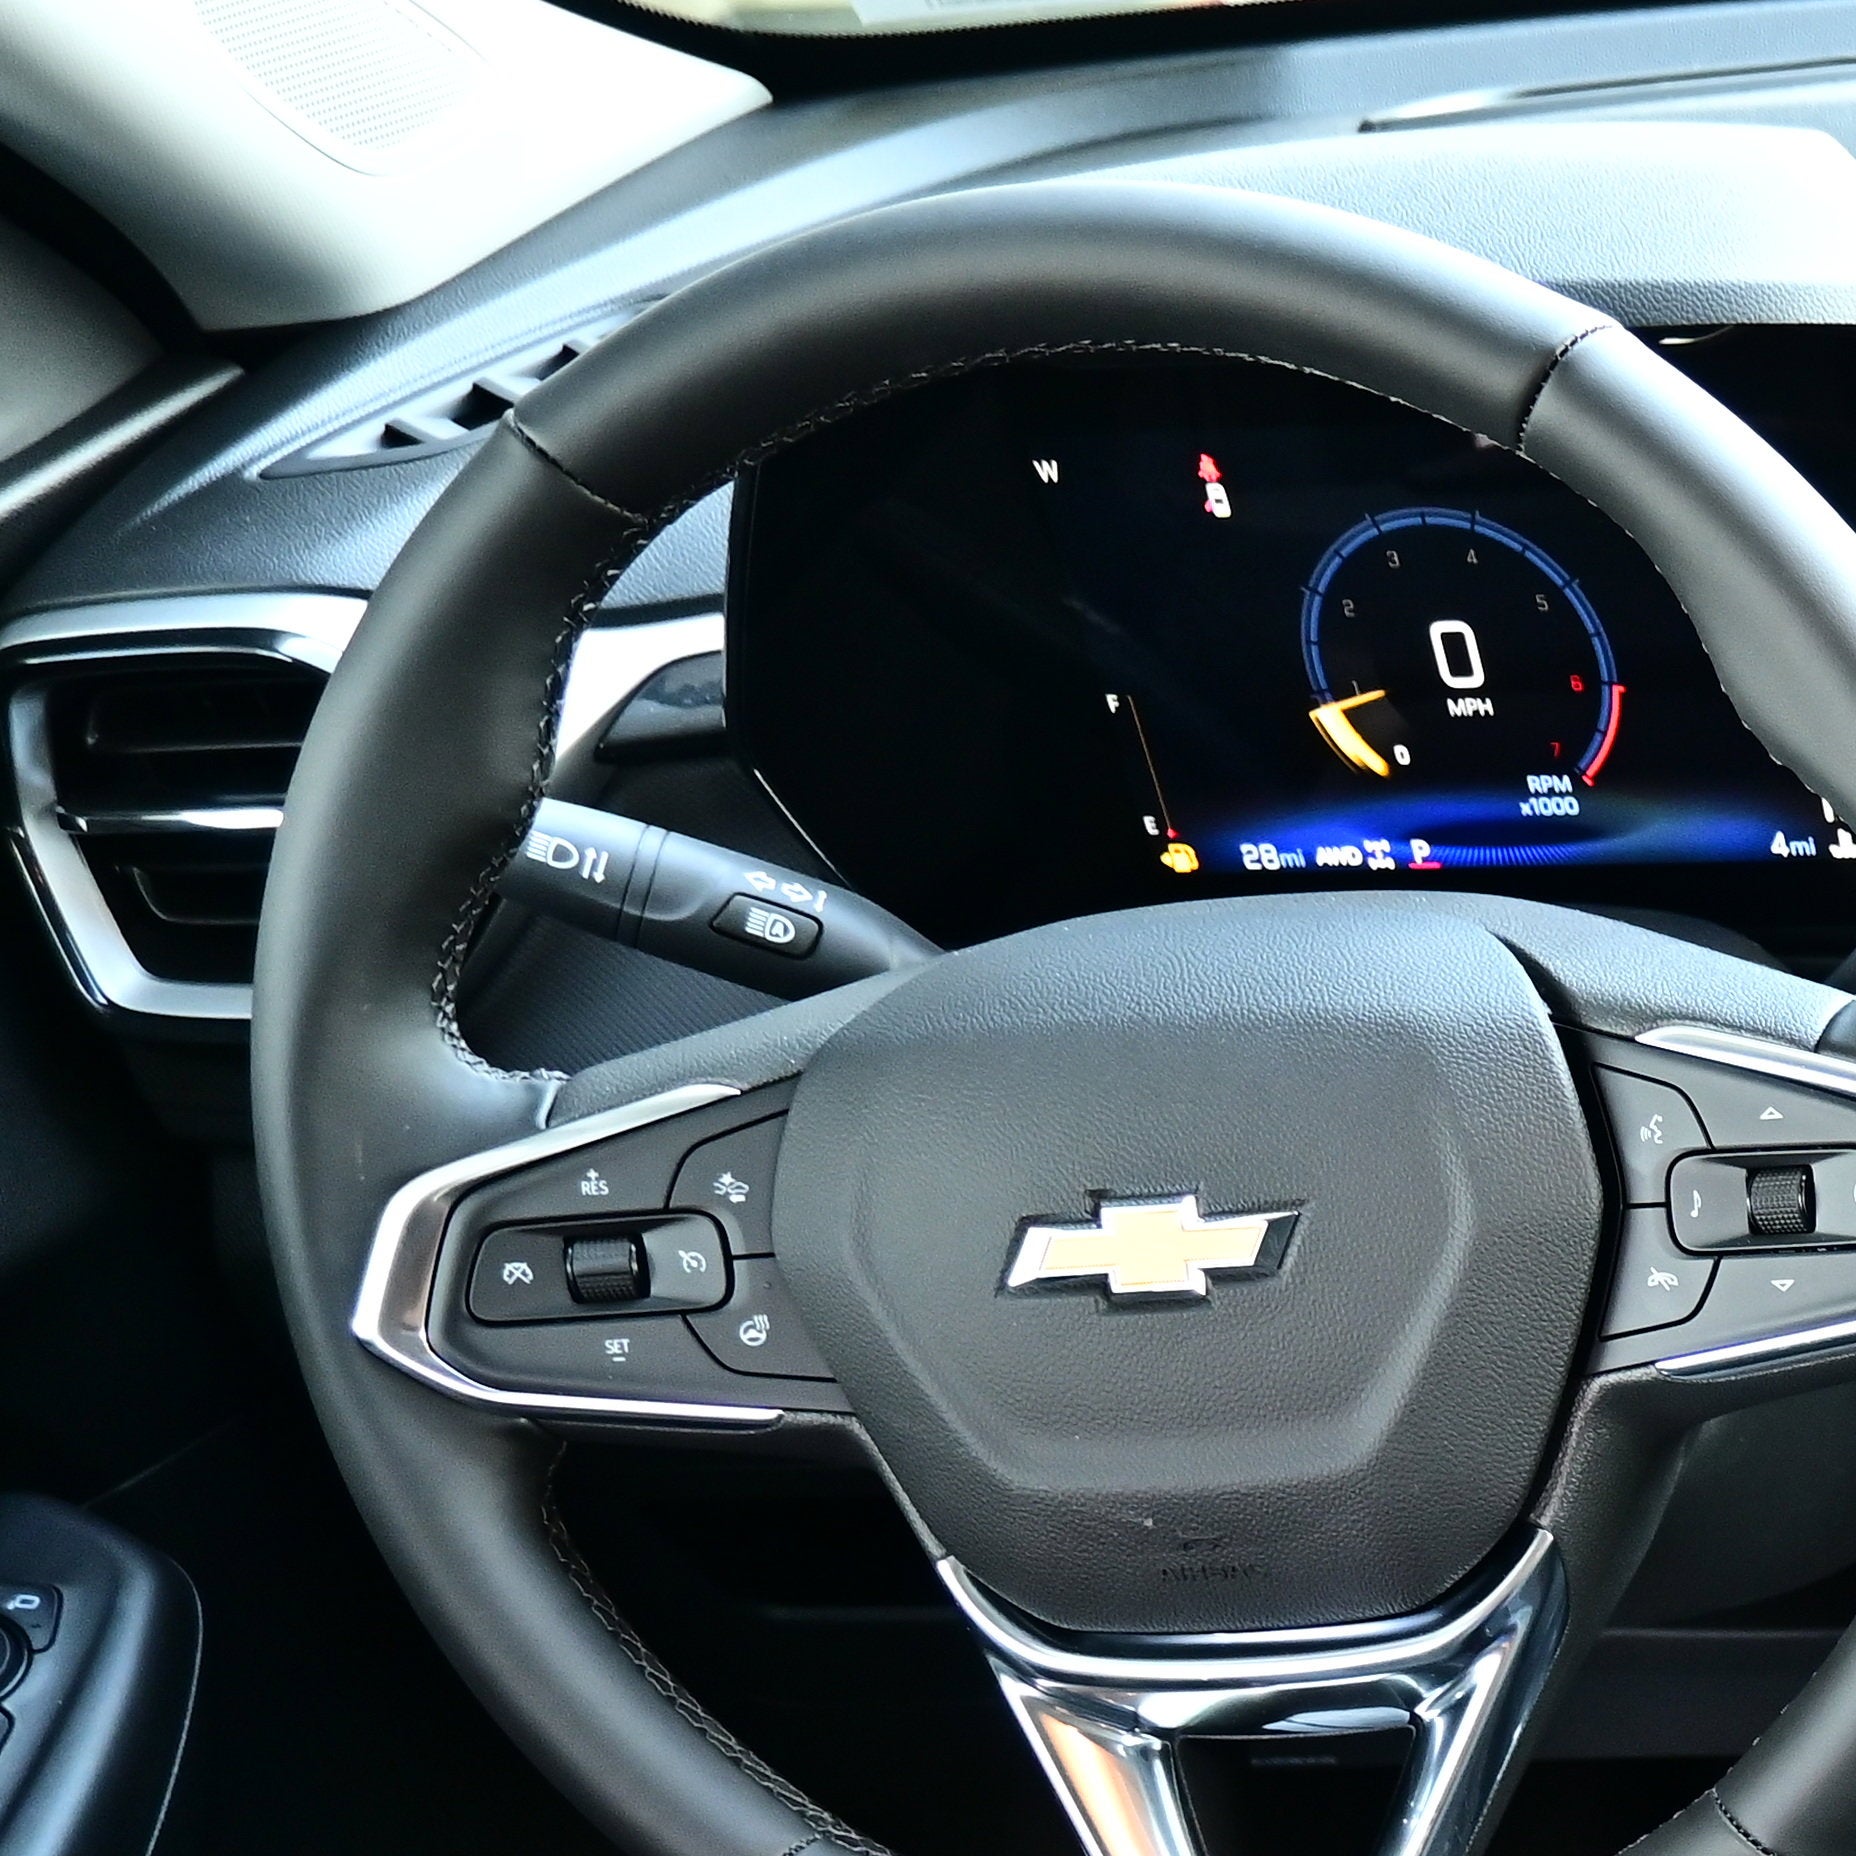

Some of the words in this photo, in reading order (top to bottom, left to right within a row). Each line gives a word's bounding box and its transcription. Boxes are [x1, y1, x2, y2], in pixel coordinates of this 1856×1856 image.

[1032, 459, 1058, 483] W
[1428, 619, 1486, 689] 0
[1105, 693, 1120, 713] F
[1446, 697, 1495, 717] MPH
[1526, 774, 1573, 794] RPM
[1519, 796, 1580, 816] x1000
[1143, 815, 1160, 836] E
[1316, 845, 1364, 868] AWD
[580, 1179, 609, 1196] RES
[604, 1338, 630, 1356] SET
